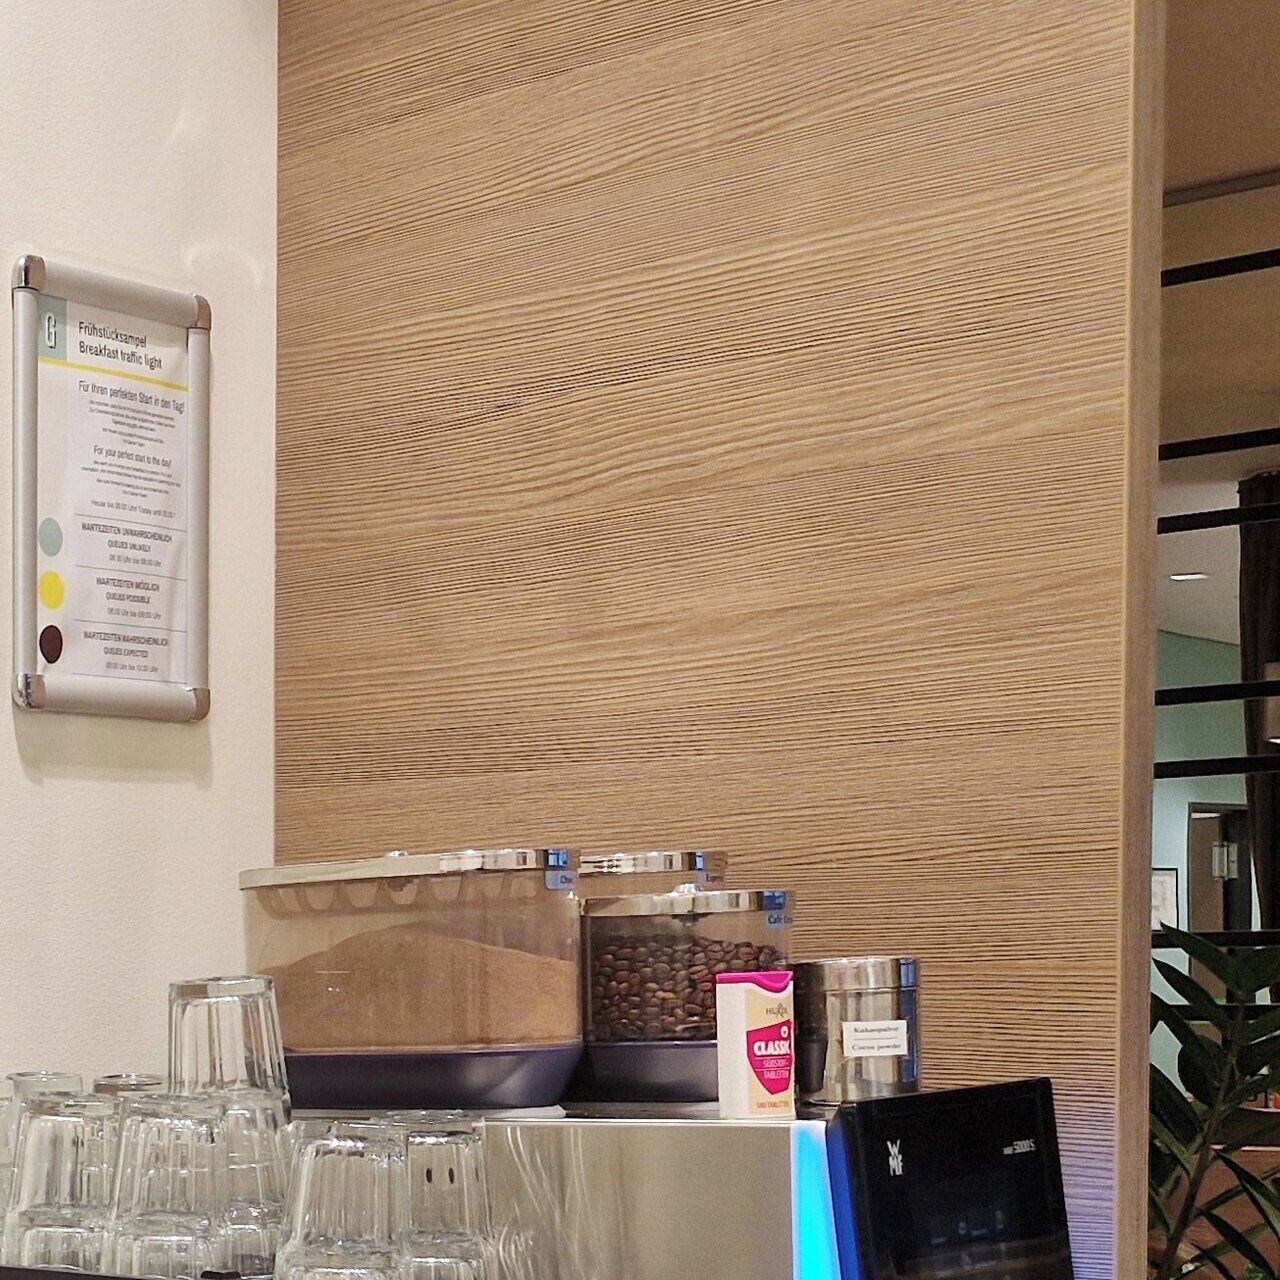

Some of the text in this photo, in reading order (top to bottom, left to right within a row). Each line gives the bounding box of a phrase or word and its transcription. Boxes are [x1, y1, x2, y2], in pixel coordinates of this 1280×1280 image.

[79, 321, 147, 349] Frühstücksampel
[79, 341, 162, 370] Breakfast traffic light
